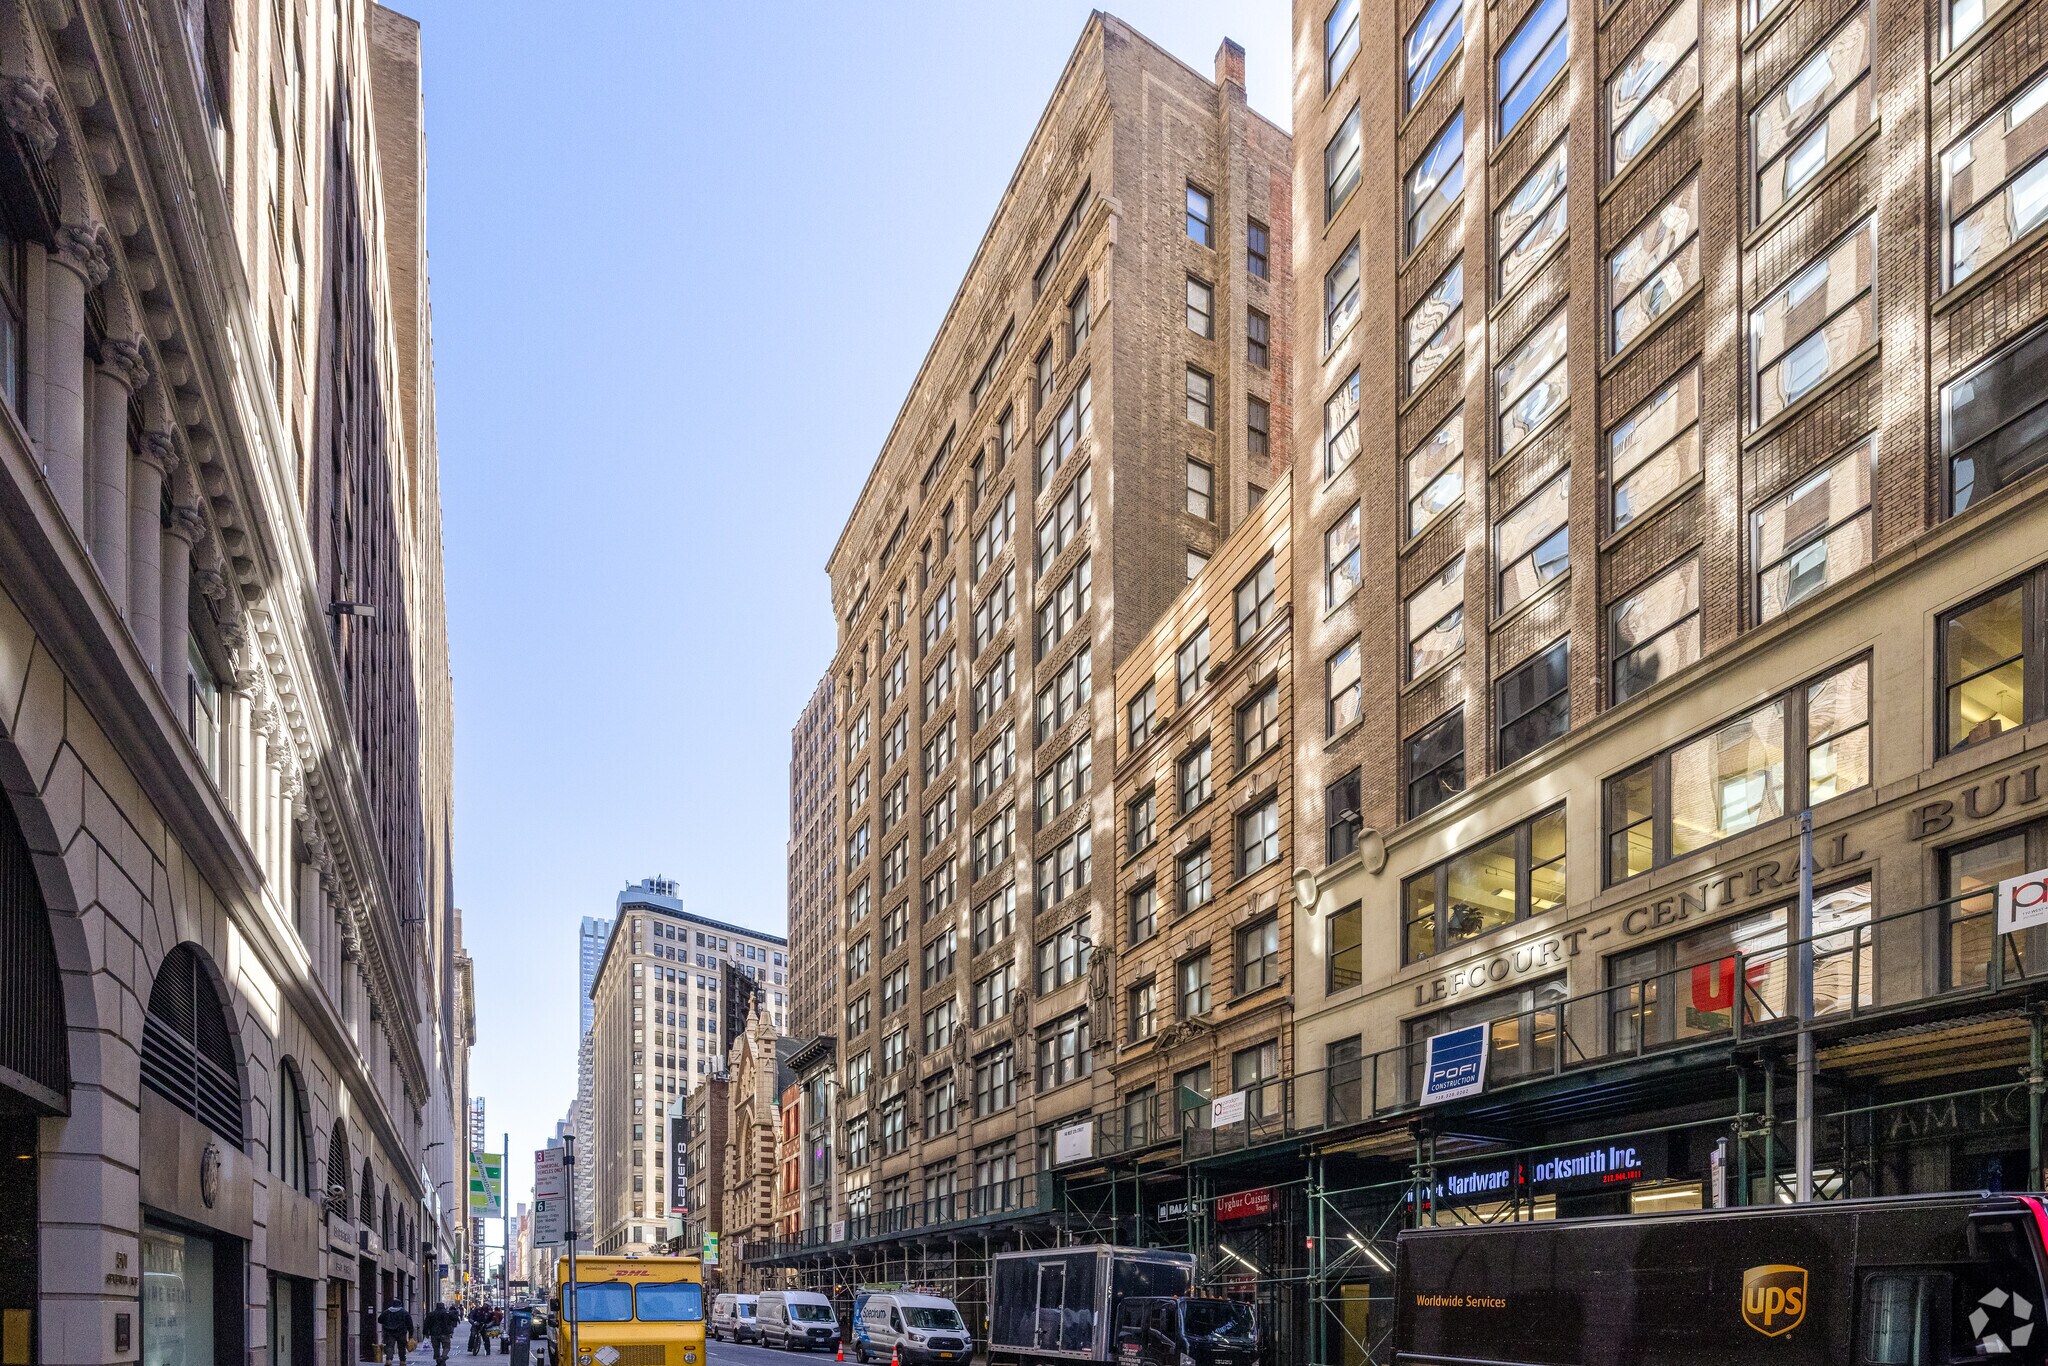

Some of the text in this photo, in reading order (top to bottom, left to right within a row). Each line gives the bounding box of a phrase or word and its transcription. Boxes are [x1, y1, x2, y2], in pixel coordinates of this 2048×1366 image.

[1414, 927, 1587, 1008] LEFCOURT
[1621, 832, 1864, 937] CENTRAL
[1432, 1062, 1477, 1083] POFI
[1431, 1074, 1476, 1092] CONSTRUCTION
[677, 1142, 687, 1154] 8
[537, 1152, 543, 1162] 3
[1448, 1170, 1510, 1196] Hardware
[1609, 1146, 1642, 1171] Inc.
[537, 1201, 544, 1212] 6
[1217, 1196, 1243, 1213] Uyghur
[1416, 1294, 1506, 1308] Worldwide Services
[862, 1307, 885, 1320] Spectrum
[520, 1318, 528, 1328] P
